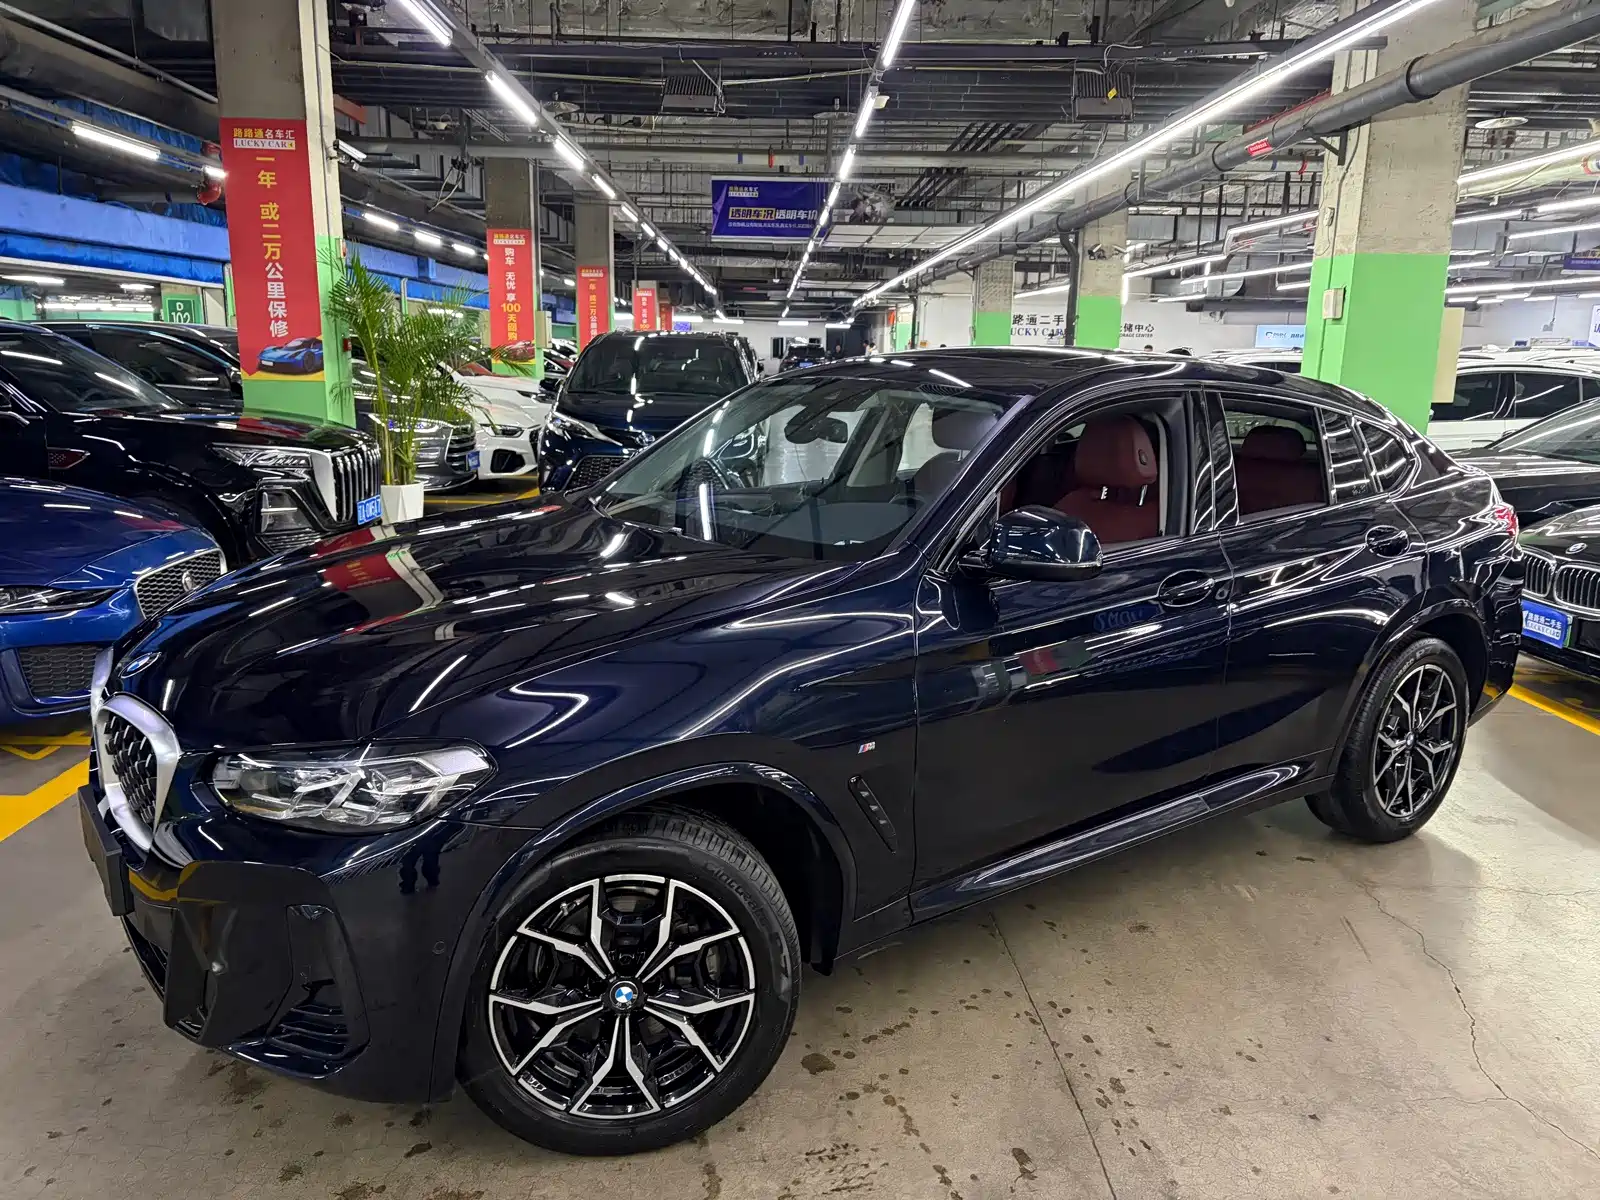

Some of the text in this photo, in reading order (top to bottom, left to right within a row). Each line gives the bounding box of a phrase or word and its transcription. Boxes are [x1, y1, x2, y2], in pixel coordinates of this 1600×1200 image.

[233, 128, 295, 139] 路路通名车汇
[268, 140, 287, 148] CAR
[259, 202, 289, 338] 或二万公里保修
[176, 302, 184, 311] D
[1012, 314, 1065, 326] 路通二手
[1120, 323, 1155, 333] 储中心
